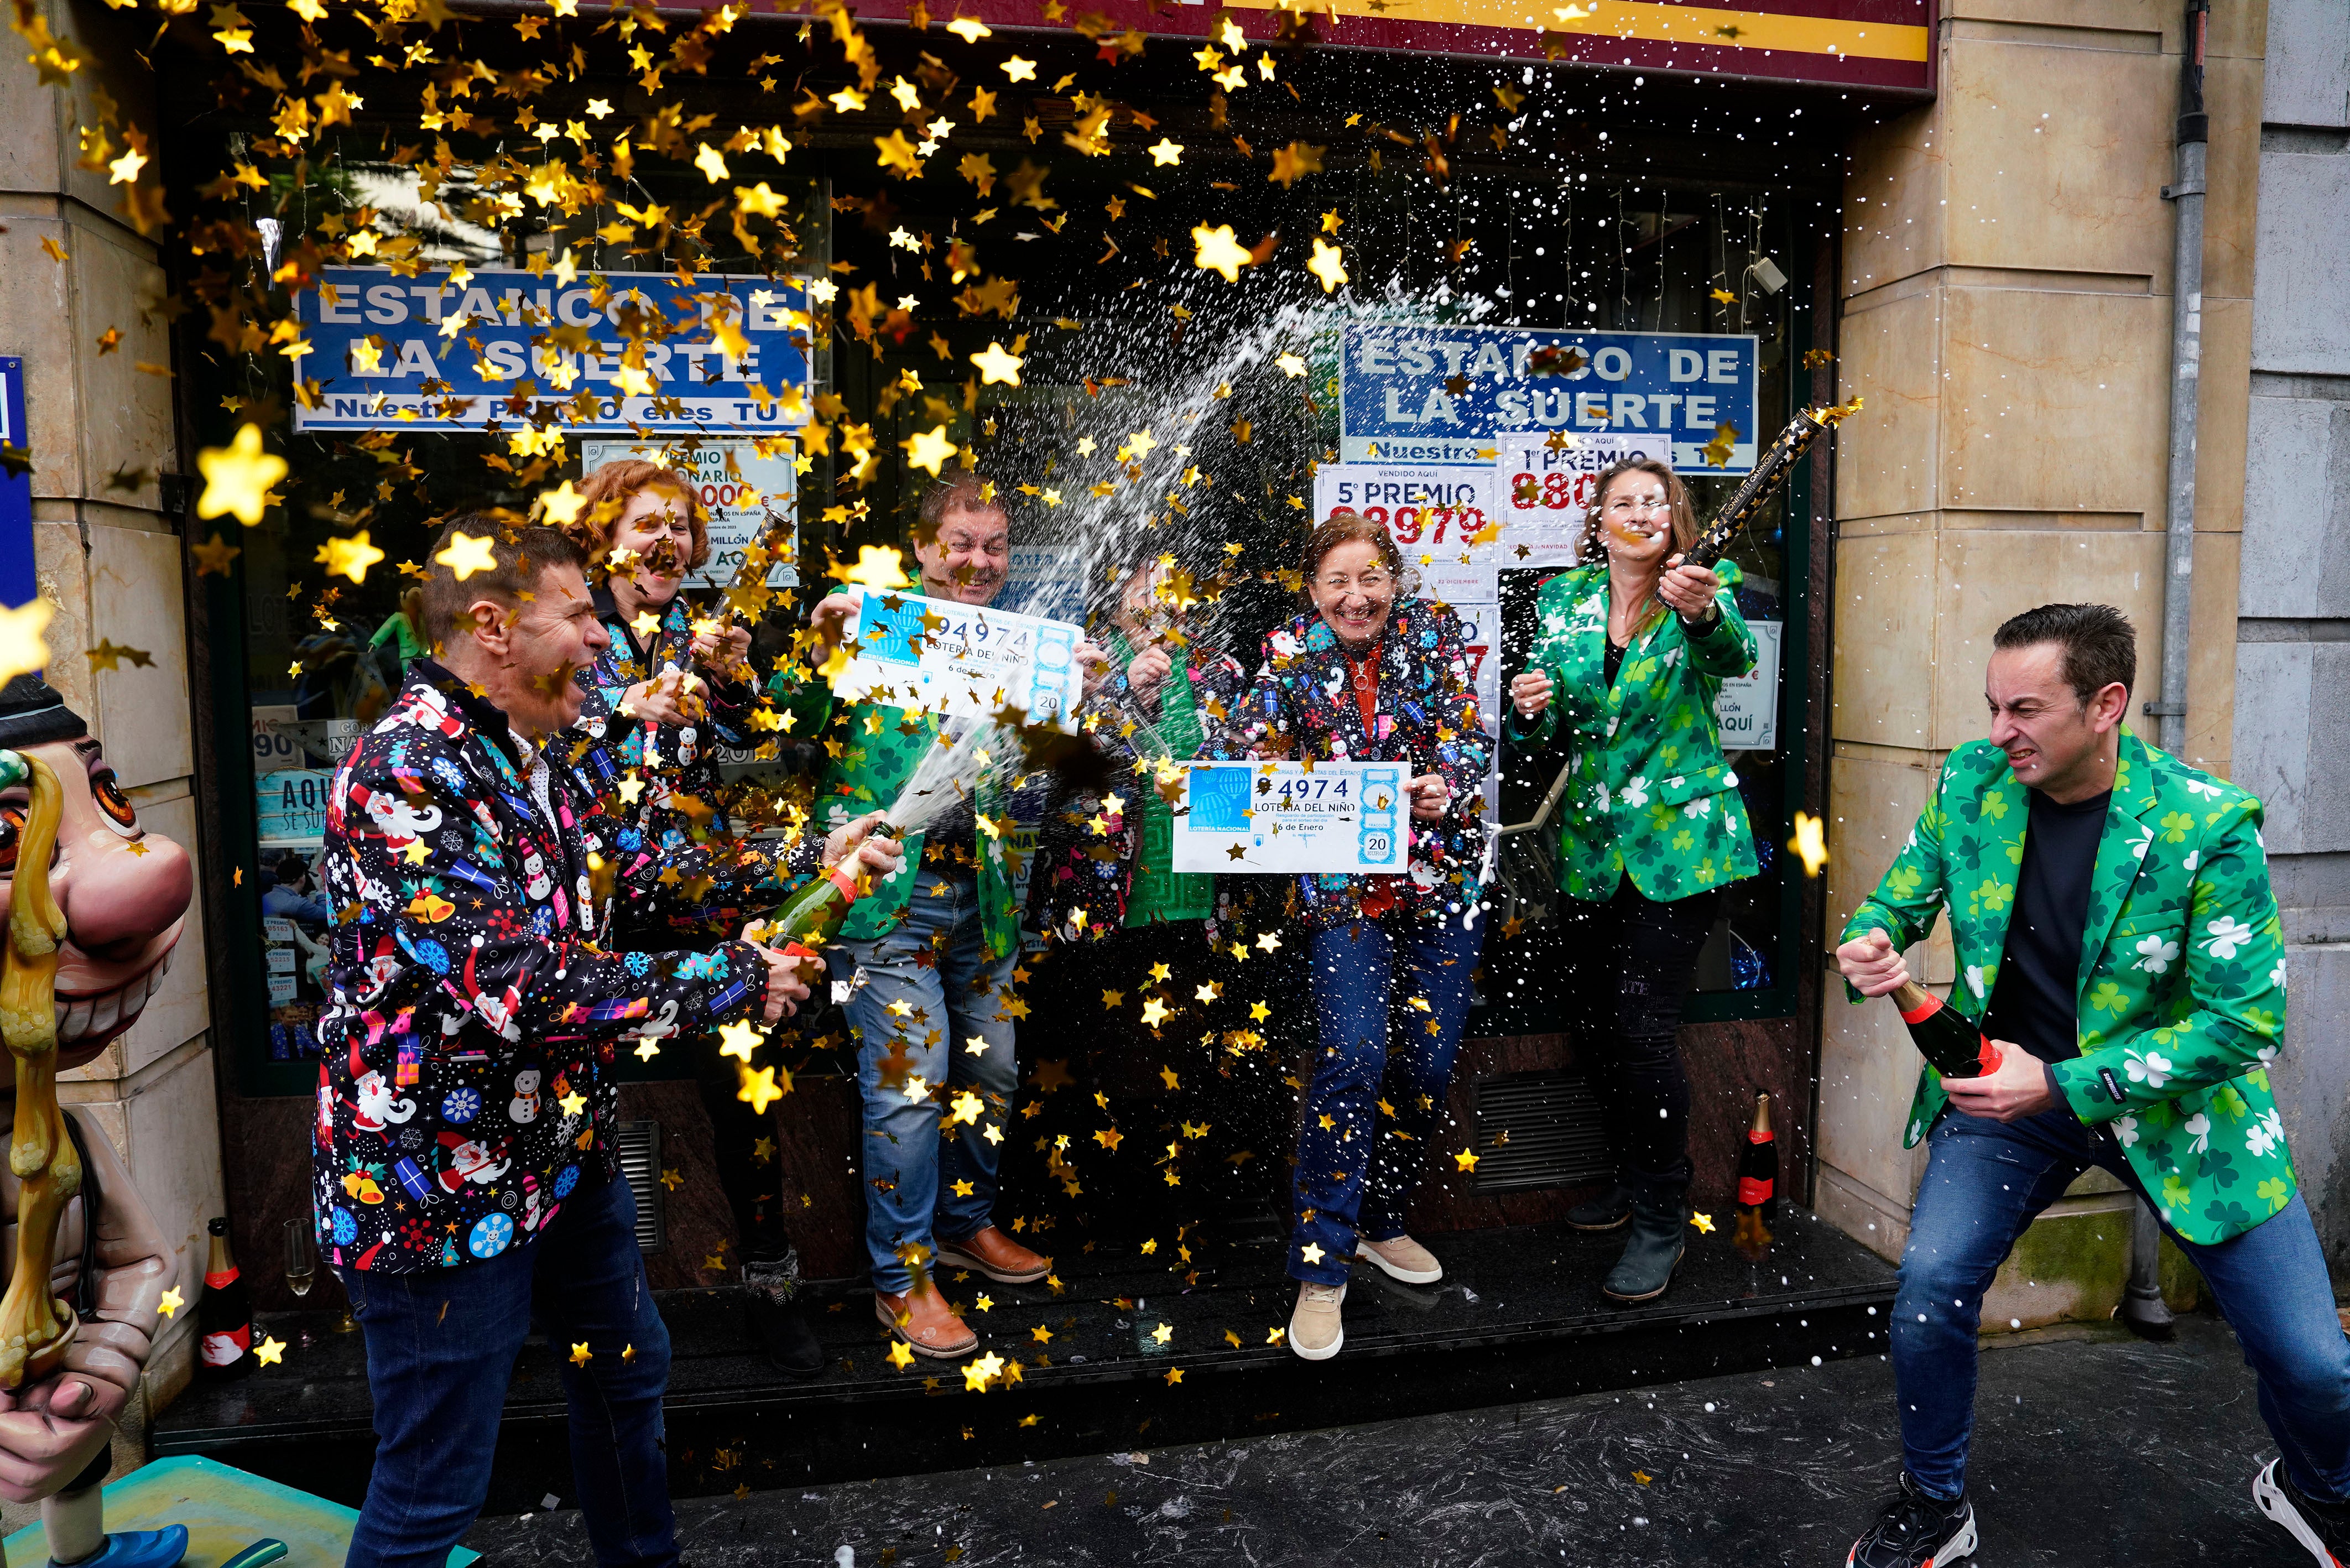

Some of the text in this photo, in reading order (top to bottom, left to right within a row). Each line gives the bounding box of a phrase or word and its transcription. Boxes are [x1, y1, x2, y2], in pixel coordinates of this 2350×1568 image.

[700, 292, 789, 331] DE
[350, 338, 761, 383] LA SUERTE
[1669, 348, 1740, 384] DE
[335, 398, 468, 419] Nuest
[733, 403, 779, 421] TU
[1385, 386, 1717, 430] LA SUERTE
[666, 452, 721, 464] REMIO
[1374, 441, 1478, 460] Nuestro
[1418, 470, 1438, 478] AQUÍ
[1724, 452, 1775, 514] CONFETTI CANNON
[1365, 483, 1476, 505] PREMIO
[1747, 481, 1760, 496] metallic
[761, 496, 769, 507] €
[711, 533, 749, 545] MILLÓN
[939, 617, 1029, 650] 94974
[884, 657, 919, 667] NACIONAL
[1752, 670, 1759, 680] €
[1040, 695, 1057, 709] 20
[1038, 707, 1059, 716] EUROS
[341, 722, 372, 733] GOR
[1717, 713, 1753, 731] AQUÍ
[254, 733, 293, 757] 90
[1305, 803, 1324, 812] DEL
[1328, 801, 1355, 812] NIÑO
[284, 811, 298, 831] SE
[1369, 838, 1386, 850] 20
[2103, 1073, 2122, 1100] SUITMEISTER
